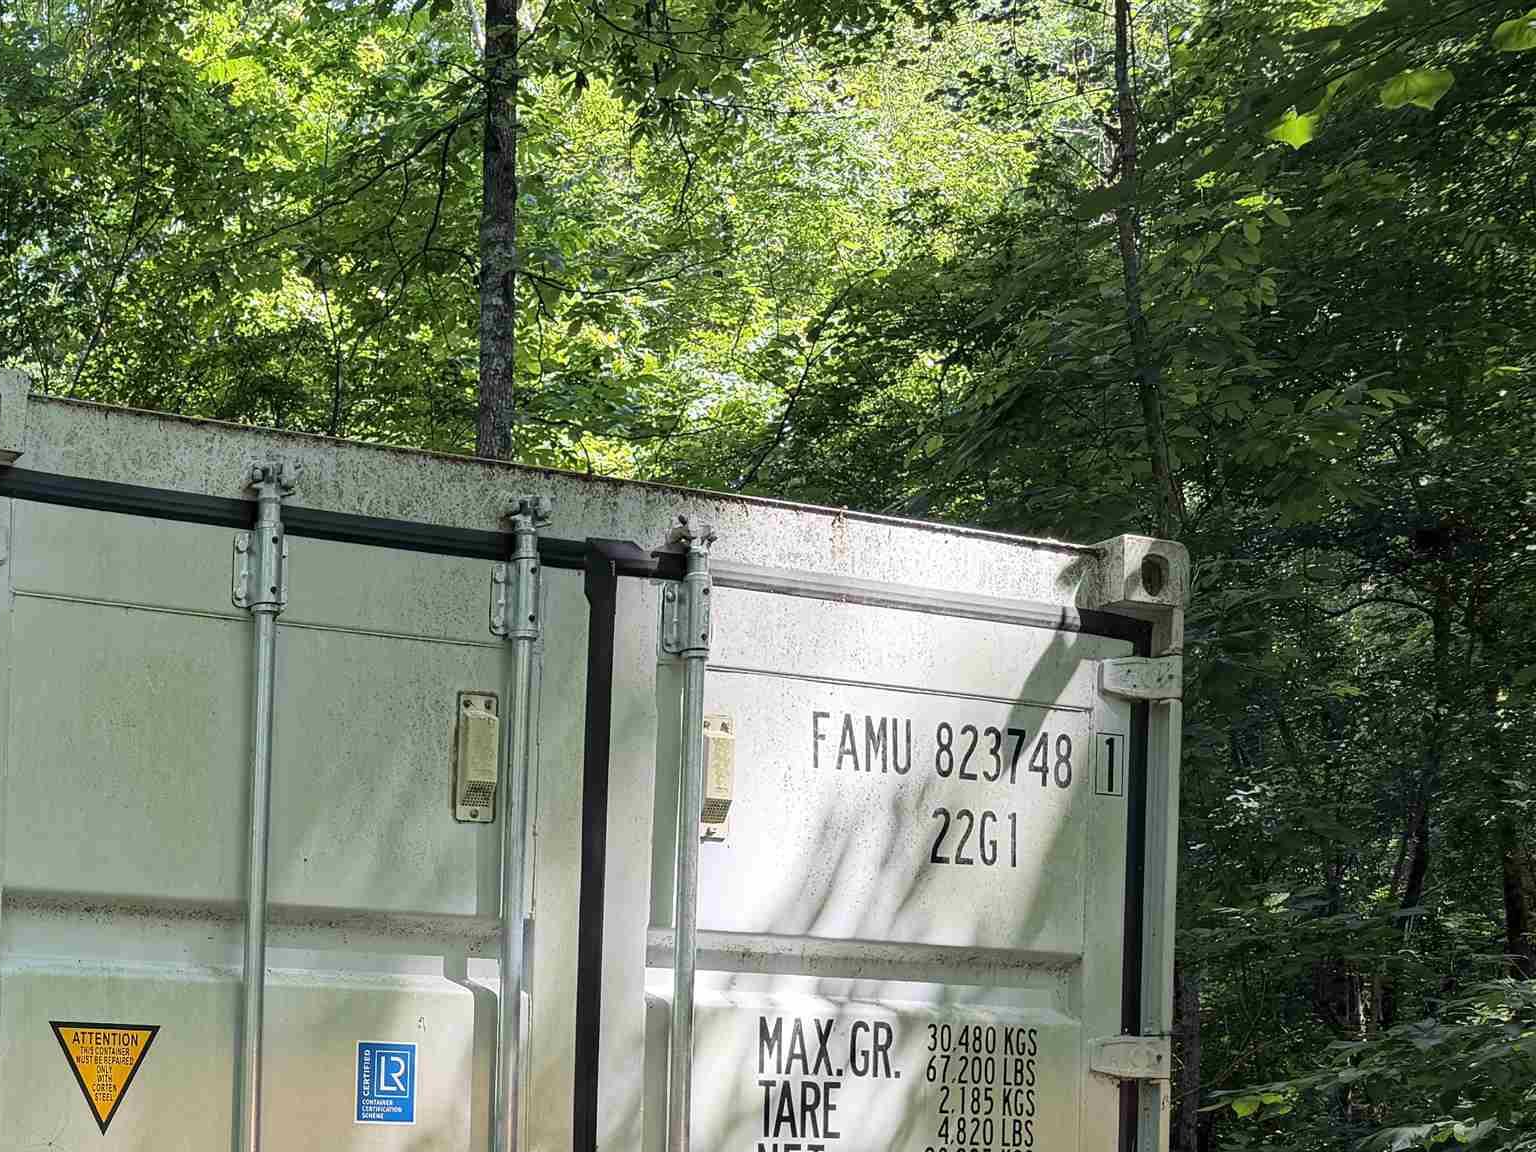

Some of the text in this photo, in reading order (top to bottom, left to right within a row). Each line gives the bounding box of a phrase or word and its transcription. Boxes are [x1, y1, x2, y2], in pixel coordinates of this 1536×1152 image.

[812, 711, 1115, 793] FAMU 823748 1
[930, 807, 1018, 868] 22G1
[72, 1032, 138, 1046] ATTENTION
[80, 1046, 130, 1056] THIS CONTAINER
[927, 1023, 1038, 1057] 30,480 KGS
[76, 1055, 93, 1064] MUST
[94, 1056, 103, 1065] BE
[96, 1065, 113, 1074] ONLY
[380, 1055, 406, 1092] LR
[926, 1055, 1036, 1087] 67,200 LBS
[758, 1080, 841, 1139] TARE
[939, 1086, 1036, 1117] 2,185 KGS
[937, 1118, 1035, 1148] 4,820 LBS
